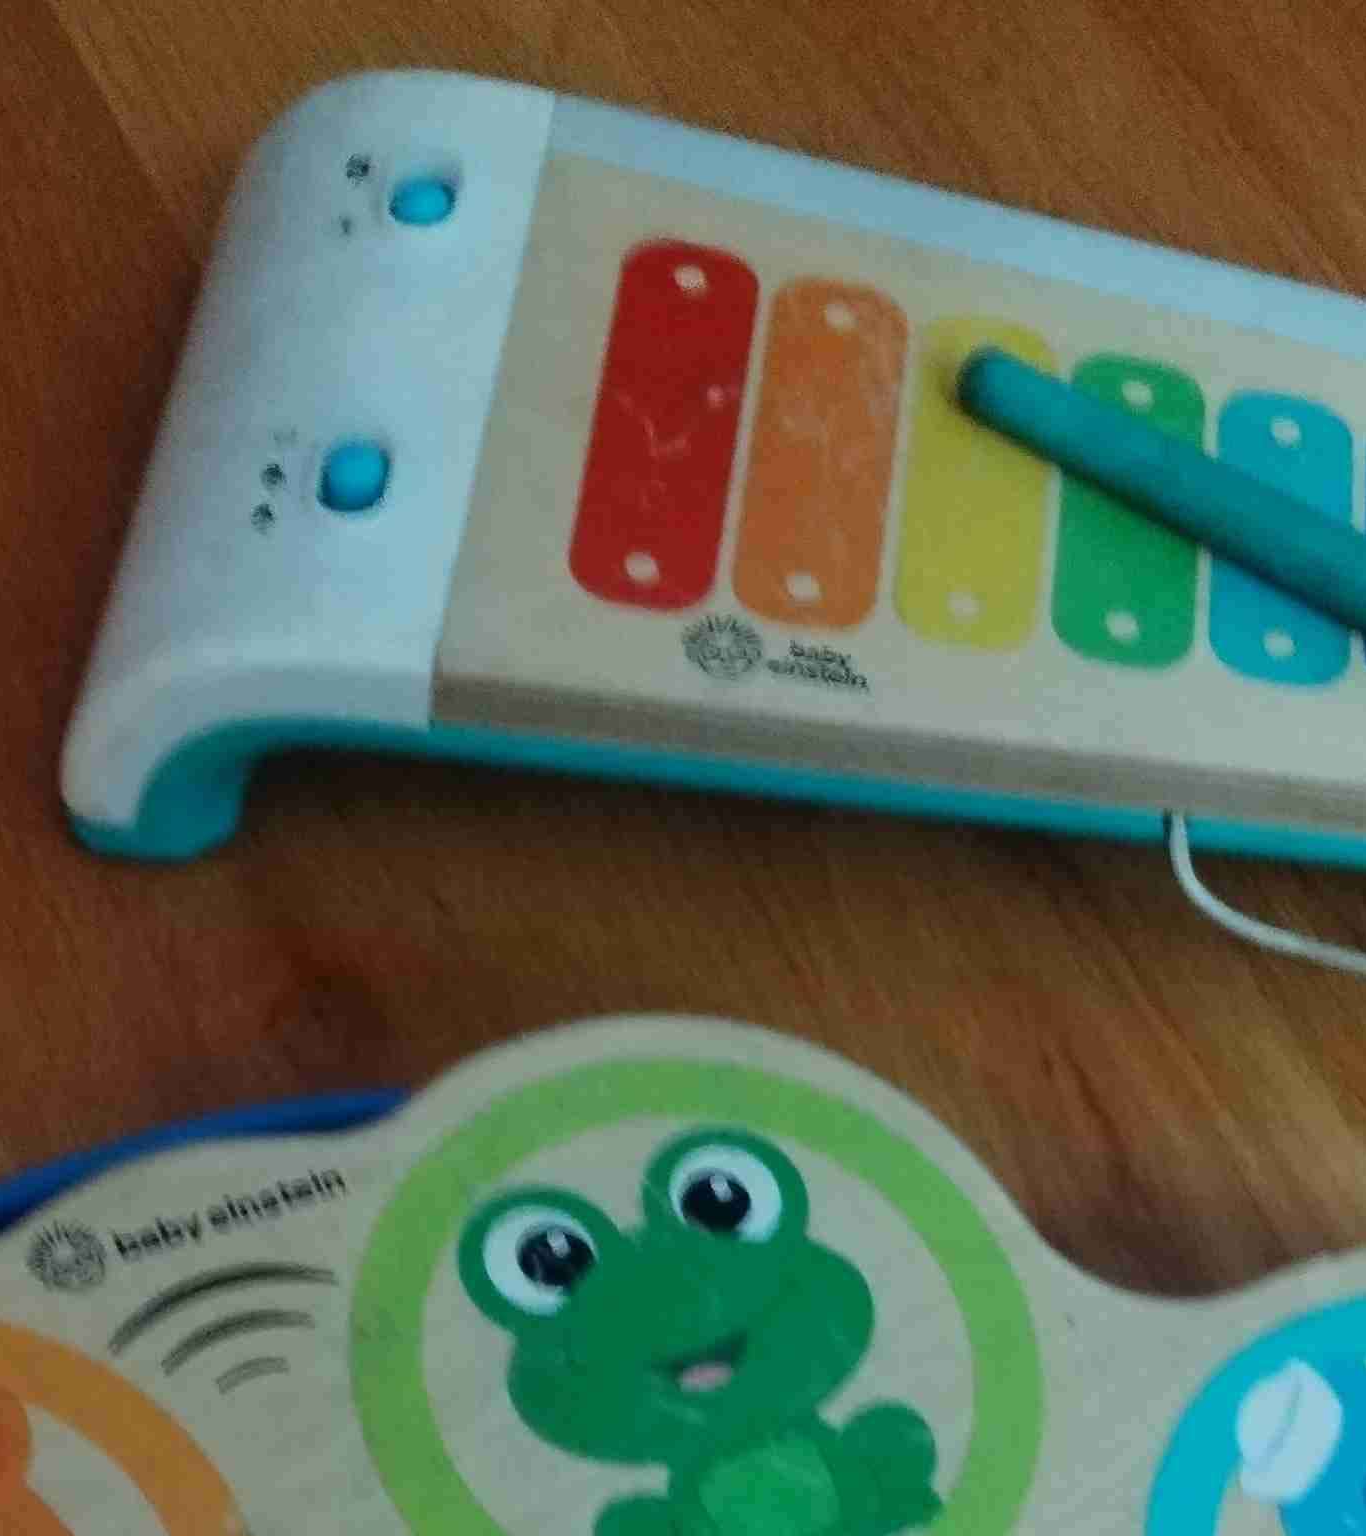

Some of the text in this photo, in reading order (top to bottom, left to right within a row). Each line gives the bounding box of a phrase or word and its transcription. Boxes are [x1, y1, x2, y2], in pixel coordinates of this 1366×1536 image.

[790, 640, 851, 667] baby
[113, 1169, 348, 1260] baby einstein
